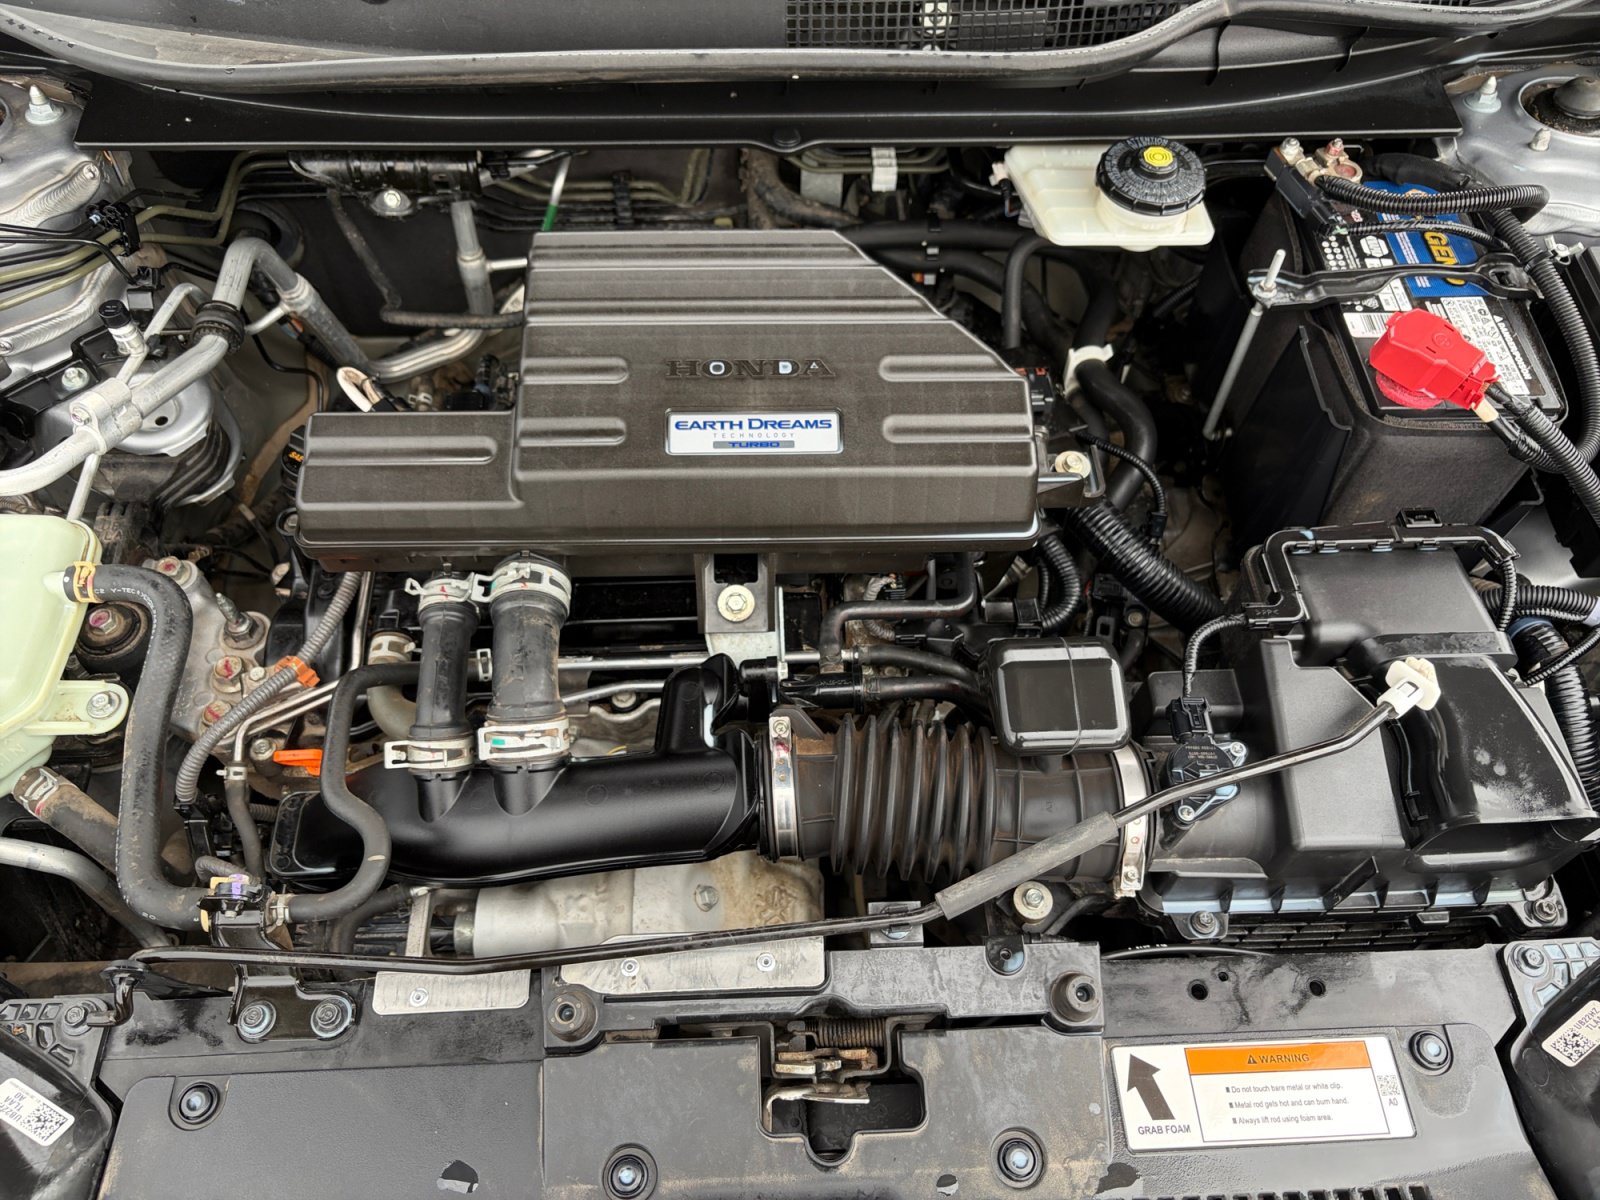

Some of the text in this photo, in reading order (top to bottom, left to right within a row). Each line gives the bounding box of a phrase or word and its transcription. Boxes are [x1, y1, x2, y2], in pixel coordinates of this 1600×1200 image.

[665, 358, 837, 379] HONDA
[674, 418, 832, 431] EARTH DREAMS
[1259, 1053, 1310, 1065] WARNING
[1271, 1084, 1285, 1092] bare
[1287, 1083, 1303, 1091] metal
[1265, 1101, 1278, 1109] gets
[1291, 1099, 1303, 1107] and
[1238, 1117, 1260, 1125] Always
[1282, 1115, 1299, 1124] using
[1300, 1114, 1316, 1122] foam
[1138, 1124, 1191, 1135] GRAB FOAM
